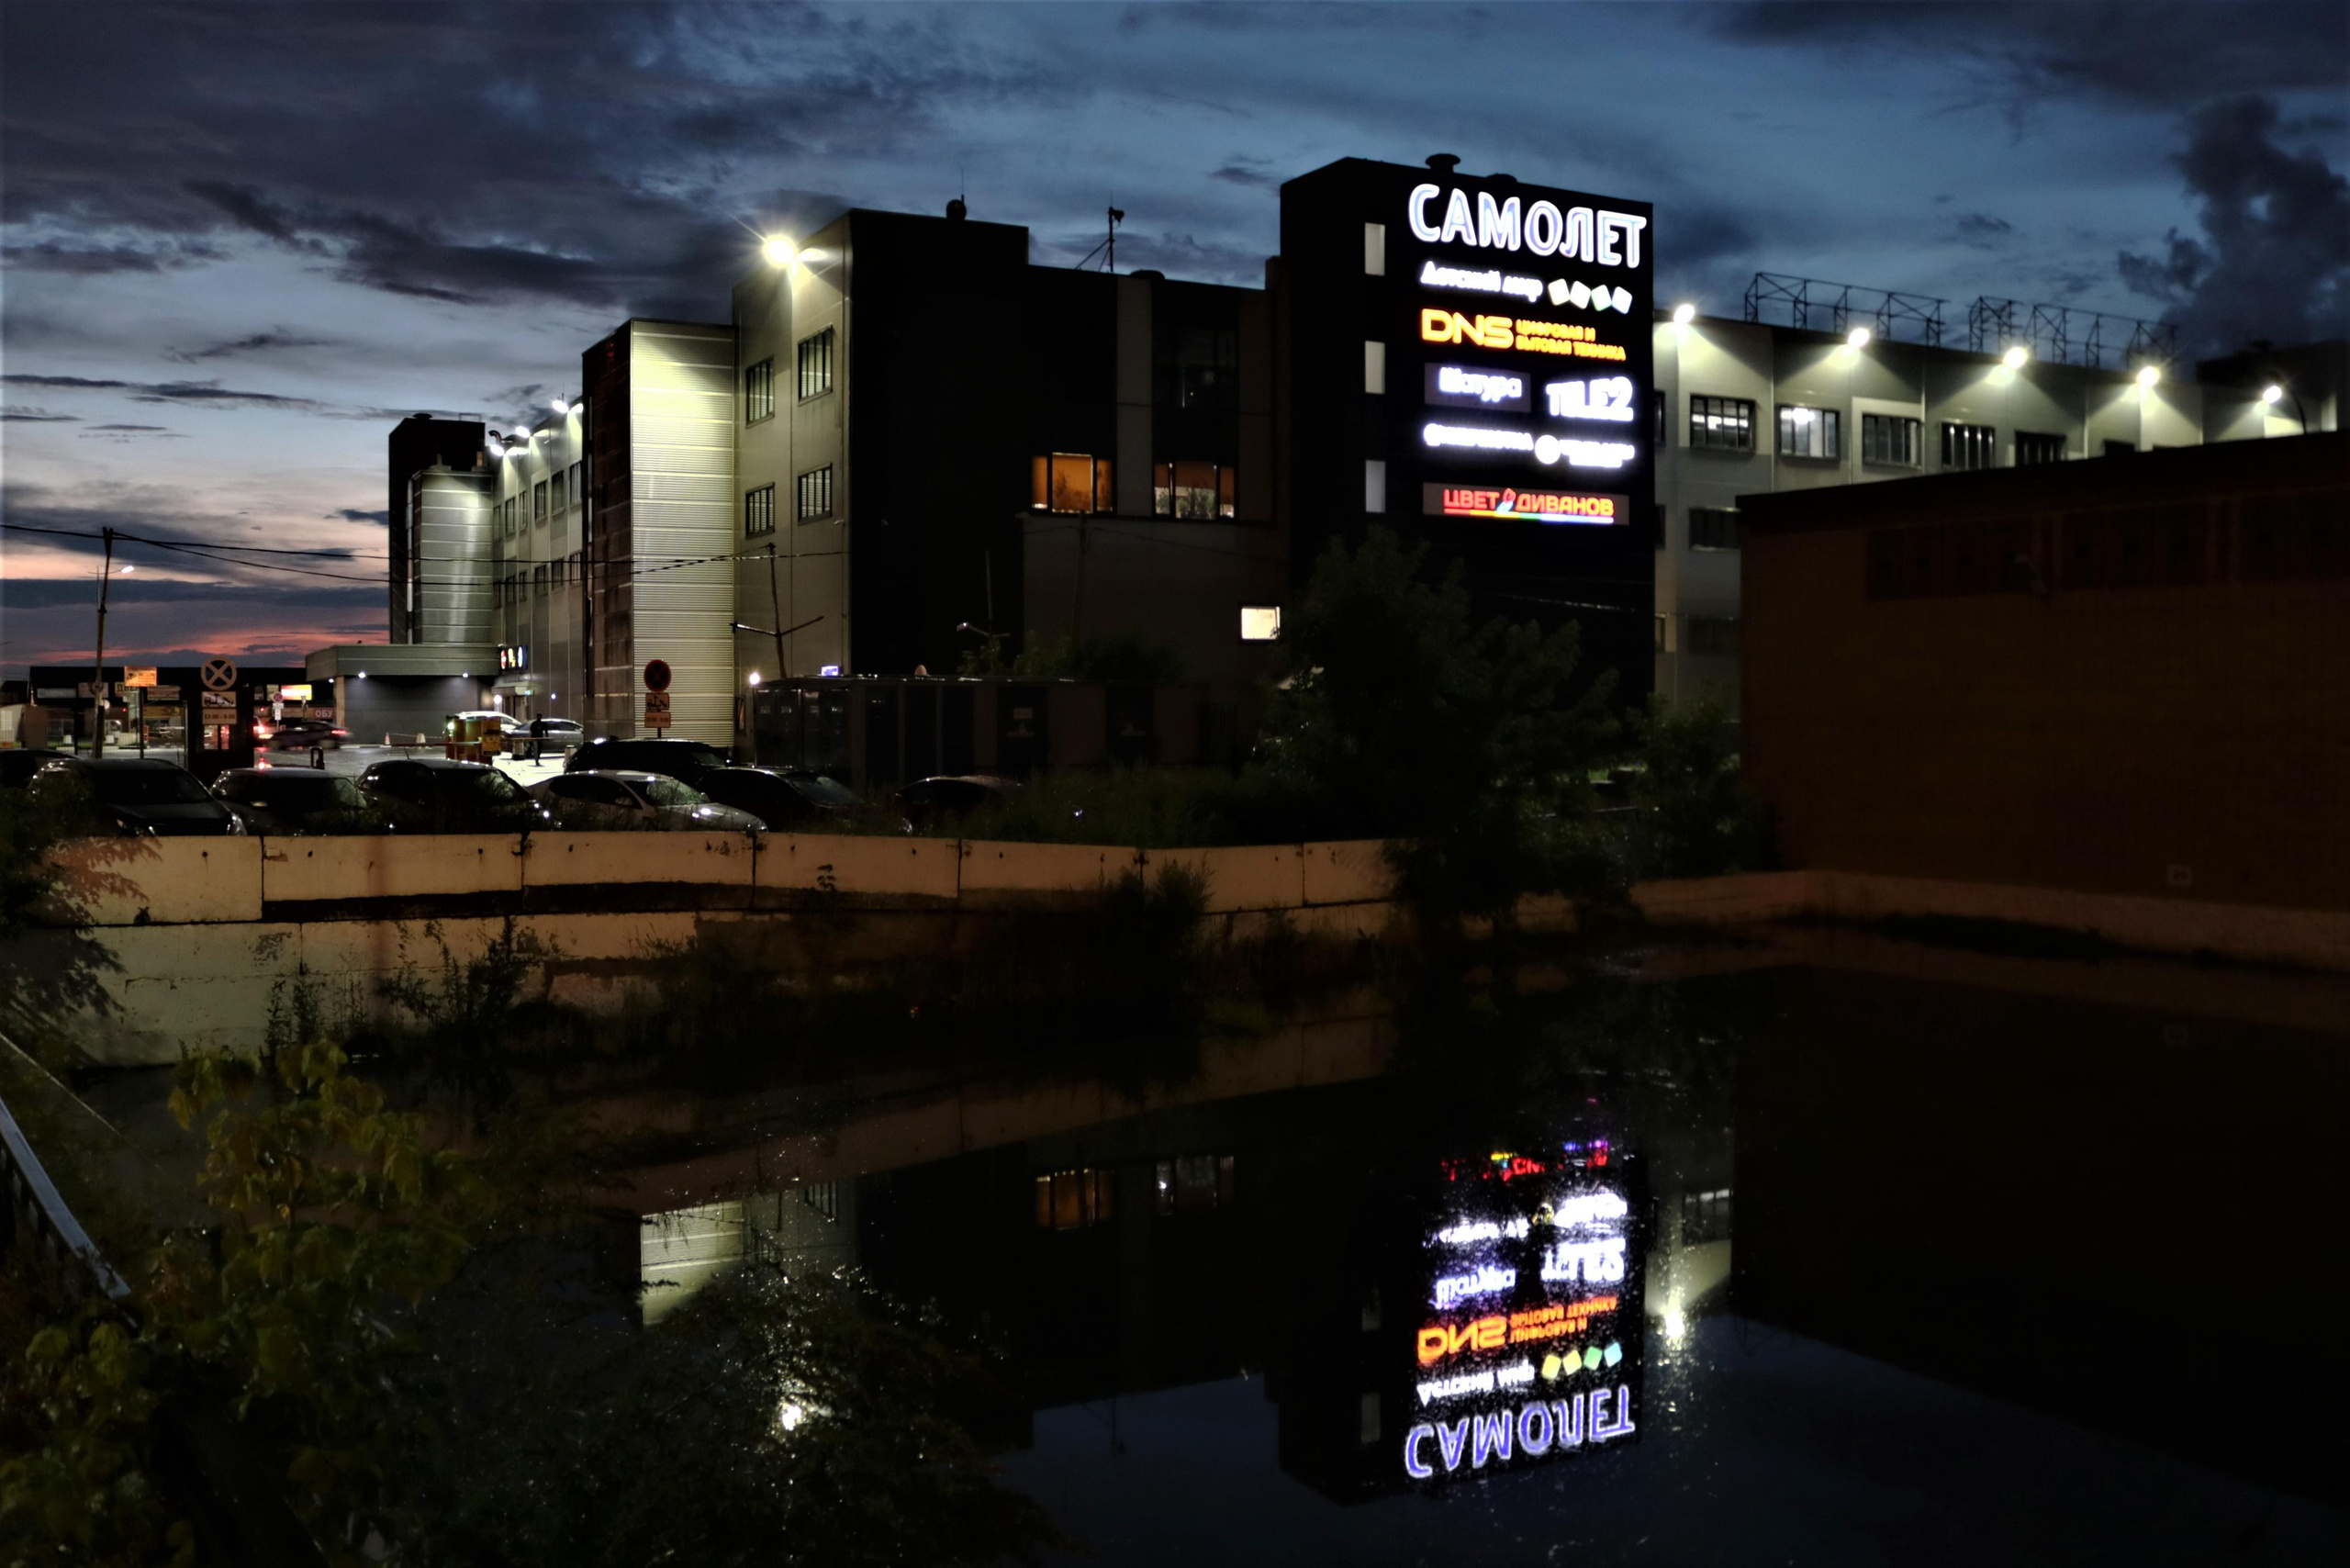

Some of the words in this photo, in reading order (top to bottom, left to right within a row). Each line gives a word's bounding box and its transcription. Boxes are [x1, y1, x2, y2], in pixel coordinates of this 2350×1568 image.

[1408, 184, 1647, 268] САМОЛЕТ
[1421, 308, 1515, 349] DNS
[1546, 375, 1634, 422] TELE2
[1443, 488, 1500, 510] ЦВЕТ
[1515, 493, 1615, 517] ДИВАНОВ
